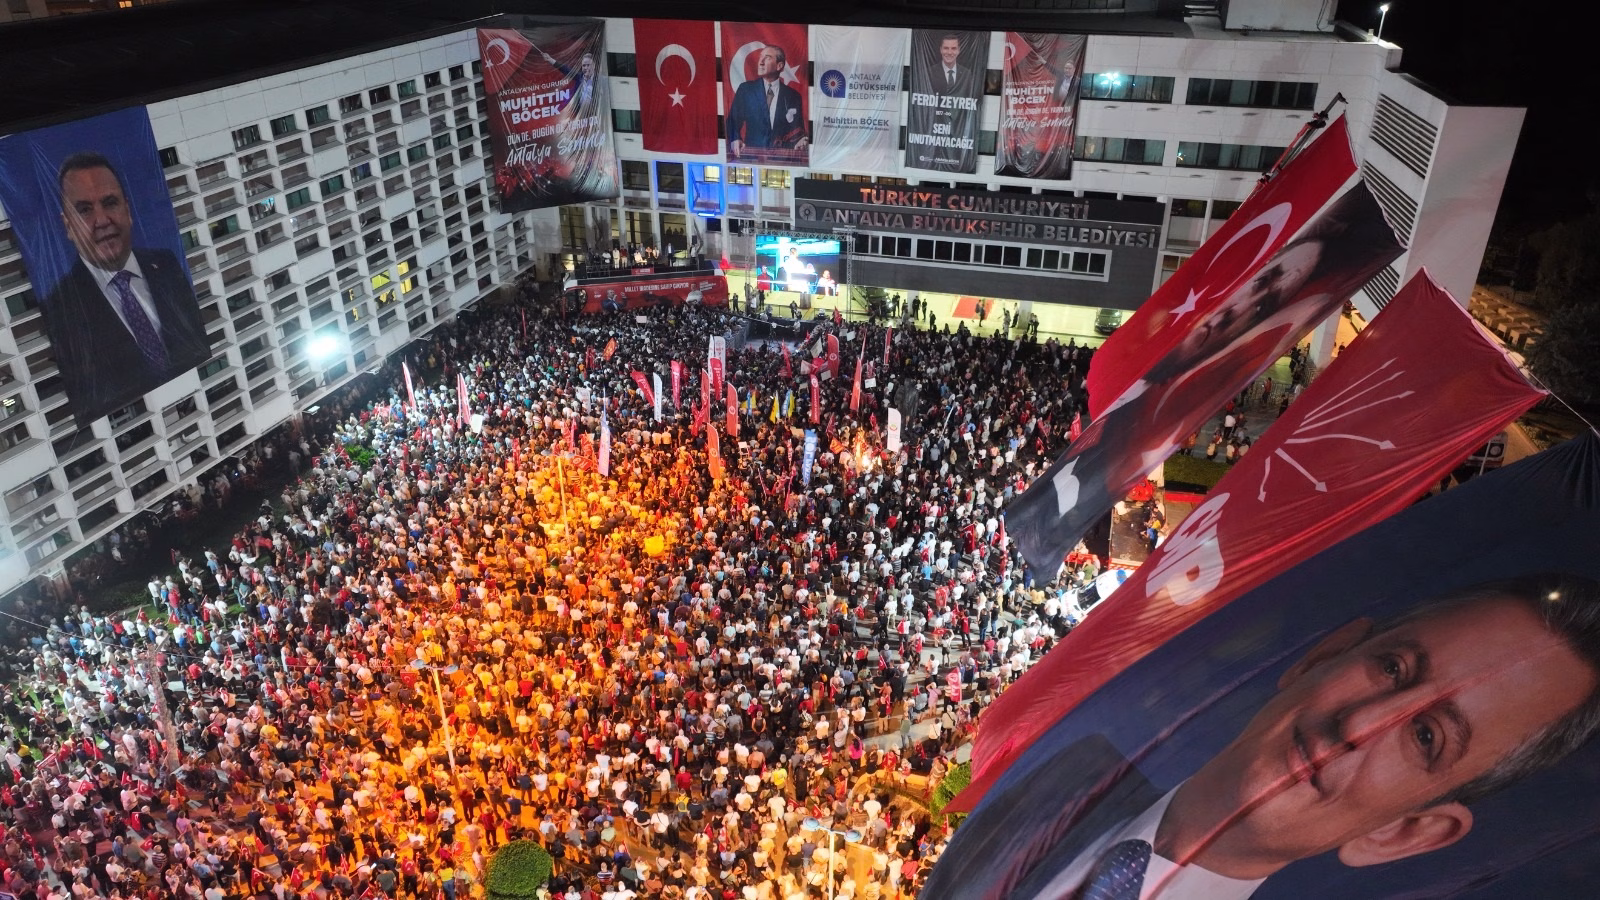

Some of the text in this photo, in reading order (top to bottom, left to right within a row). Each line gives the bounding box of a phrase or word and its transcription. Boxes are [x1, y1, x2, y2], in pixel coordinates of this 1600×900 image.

[541, 79, 569, 90] GURURU
[848, 82, 896, 91] BÜYÜKŞEHİR
[1005, 85, 1054, 95] MUHİTTİN
[500, 88, 570, 112] MUHİTTİN
[911, 92, 978, 110] FERDİ ZEYREK
[1011, 95, 1046, 104] BÖCEK
[512, 104, 561, 124] BÖCEK
[823, 116, 889, 126] Muhittin BÖCEK
[508, 133, 521, 145] DÜN
[532, 124, 555, 139] BUGÜN
[933, 122, 951, 135] SENİ
[909, 133, 974, 149] UNUTMAYACAĞIZ
[505, 143, 551, 167] Antalya
[860, 185, 1090, 220] TÜRKİYE CUMHURİYETİ
[821, 208, 1156, 249] ANTALYA BÜYÜKŞEHİR BELEDİYESİ
